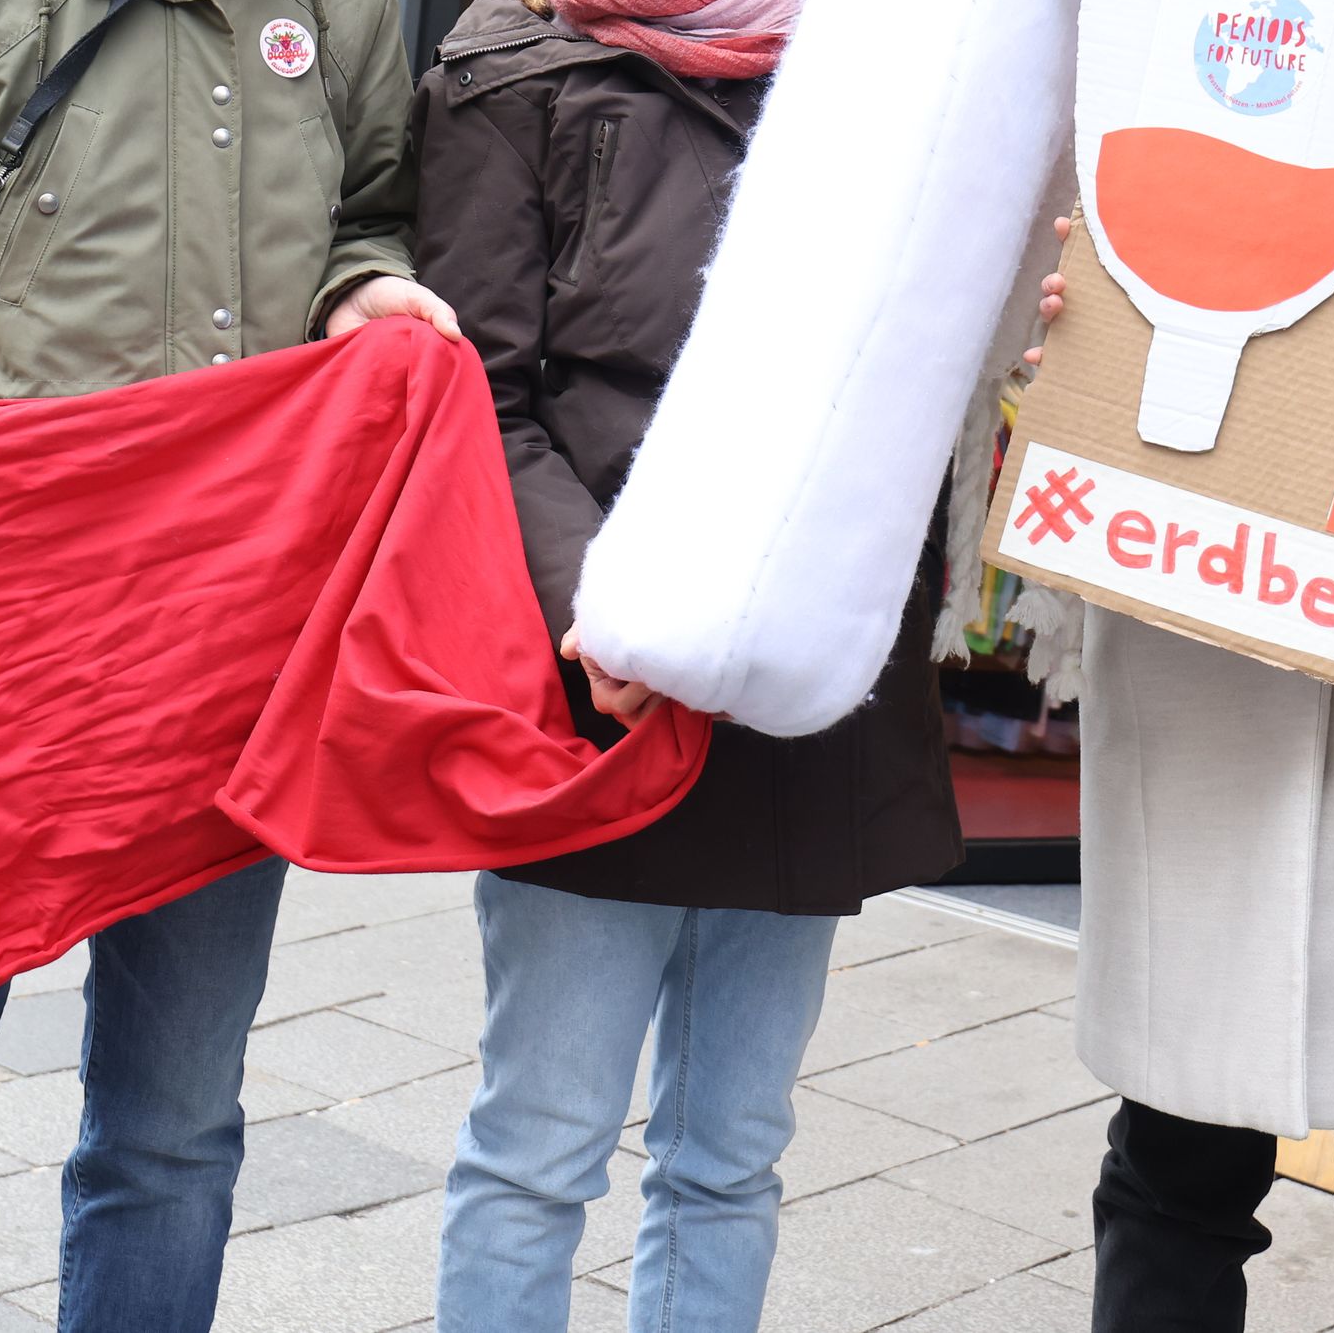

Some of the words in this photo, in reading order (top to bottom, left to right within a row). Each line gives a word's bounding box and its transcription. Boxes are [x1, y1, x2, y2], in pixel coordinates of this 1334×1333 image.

[1215, 12, 1306, 47] PERIODS
[267, 48, 310, 62] bloody
[1207, 43, 1234, 64] FOR
[1241, 47, 1307, 72] FUTURE
